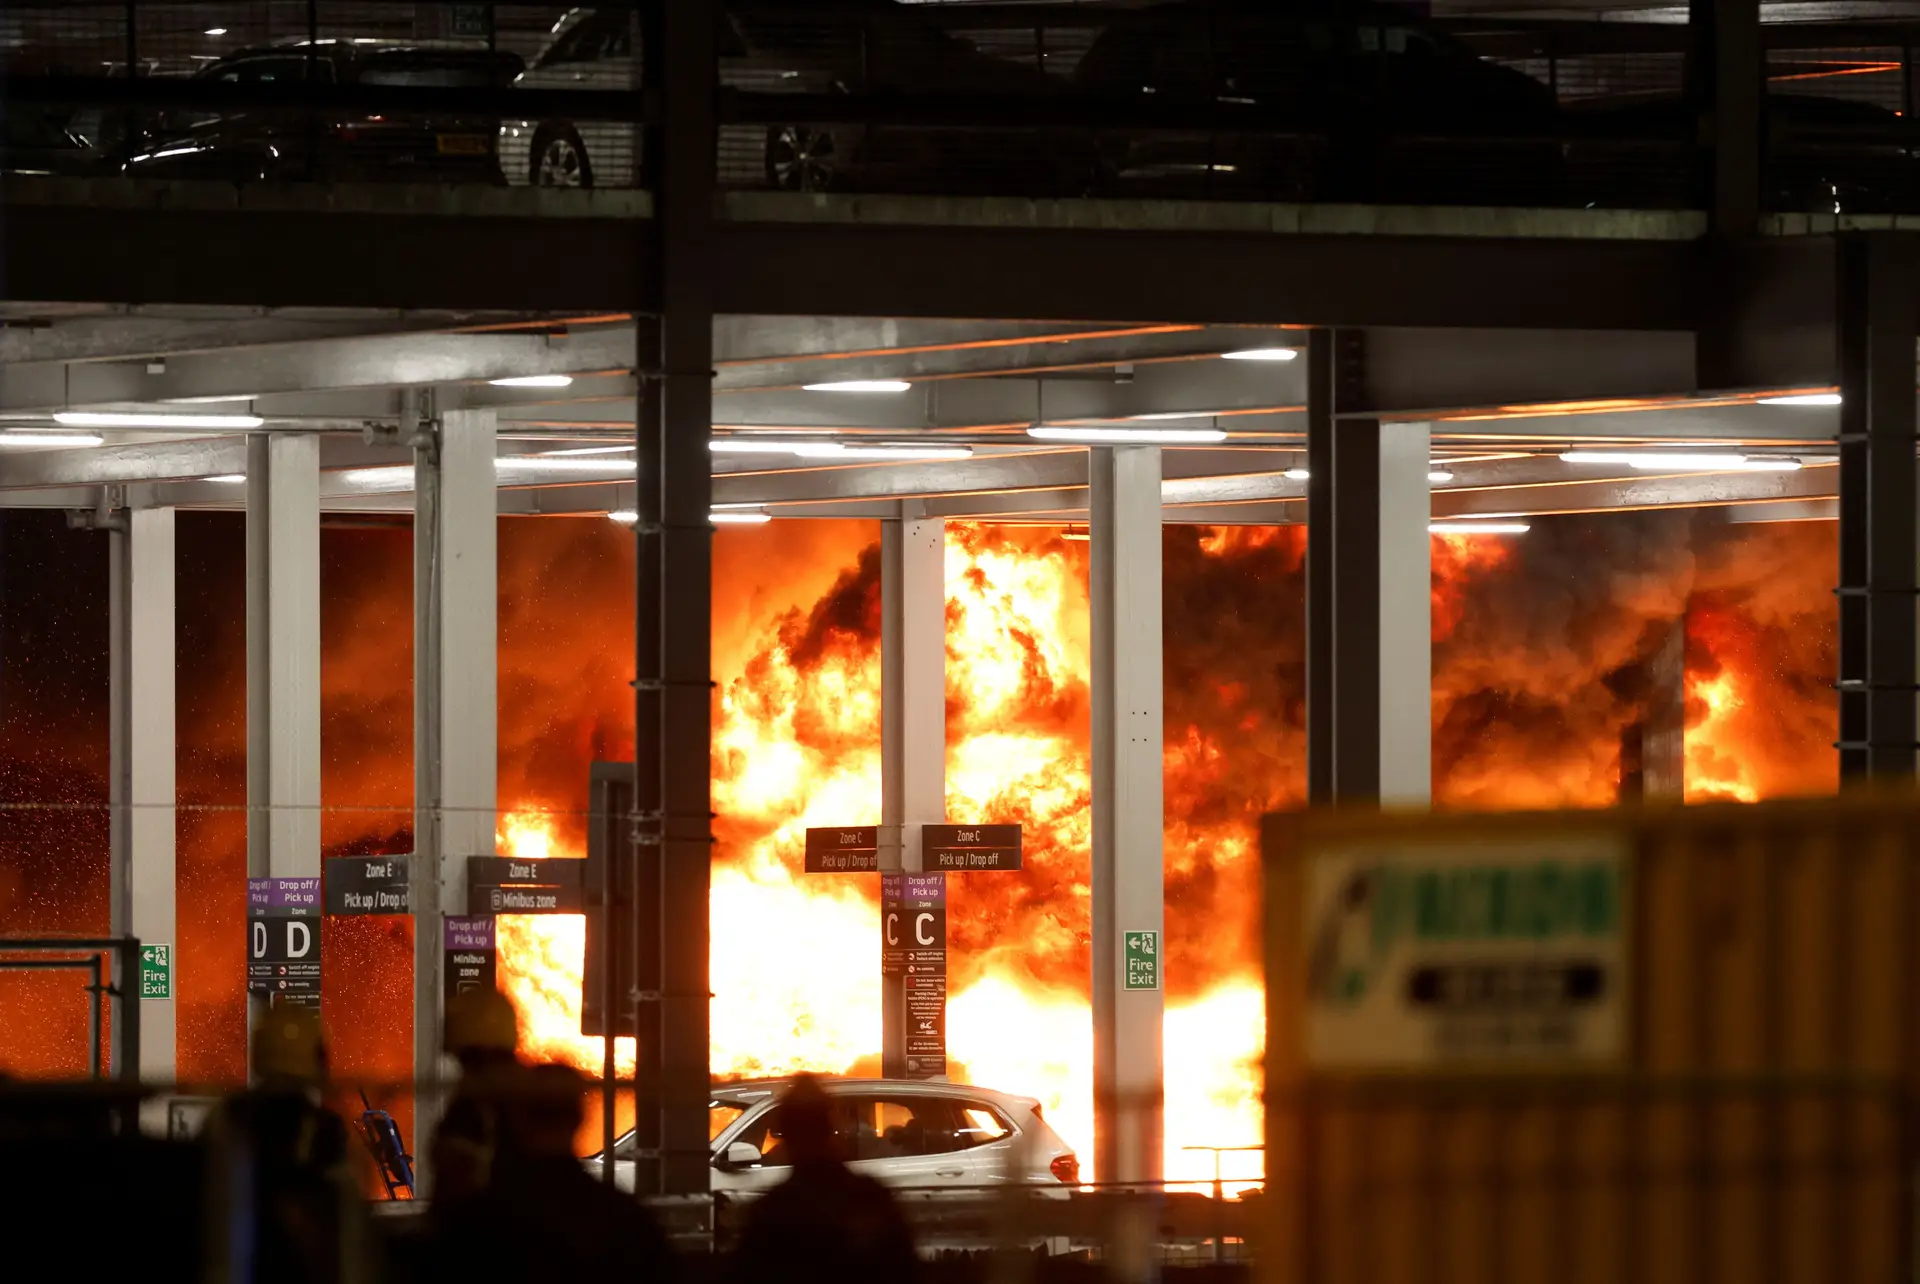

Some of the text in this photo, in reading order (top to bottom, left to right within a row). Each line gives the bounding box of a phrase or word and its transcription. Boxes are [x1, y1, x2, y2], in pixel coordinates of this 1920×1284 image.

[840, 831, 862, 844] Zone C
[958, 830, 980, 842] Zone C
[822, 855, 836, 868] Pick
[837, 857, 846, 870] up
[847, 854, 852, 868] /
[852, 854, 868, 869] Drop
[940, 852, 999, 868] Pick up / Drop off
[366, 862, 392, 878] Zone E
[510, 863, 536, 878] Zone E
[280, 880, 320, 891] Drop off /
[908, 876, 926, 886] Drop
[926, 876, 938, 884] off
[284, 893, 314, 904] Pick up
[912, 888, 938, 898] Pick up
[344, 892, 362, 908] Pick
[362, 894, 373, 910] up
[374, 891, 379, 908] /
[380, 892, 400, 910] Drop
[502, 892, 556, 908] Minibus zone
[449, 921, 470, 932] Drop
[472, 920, 487, 931] off
[887, 913, 898, 946] C
[916, 912, 934, 946] C
[254, 922, 268, 958] D
[287, 922, 310, 958] D
[454, 934, 487, 946] Pick up
[454, 954, 486, 964] Minibus
[1130, 958, 1154, 970] Fire
[144, 970, 166, 981] Fire
[460, 968, 480, 976] zone
[1130, 972, 1154, 984] Exit
[144, 982, 166, 994] Exit
